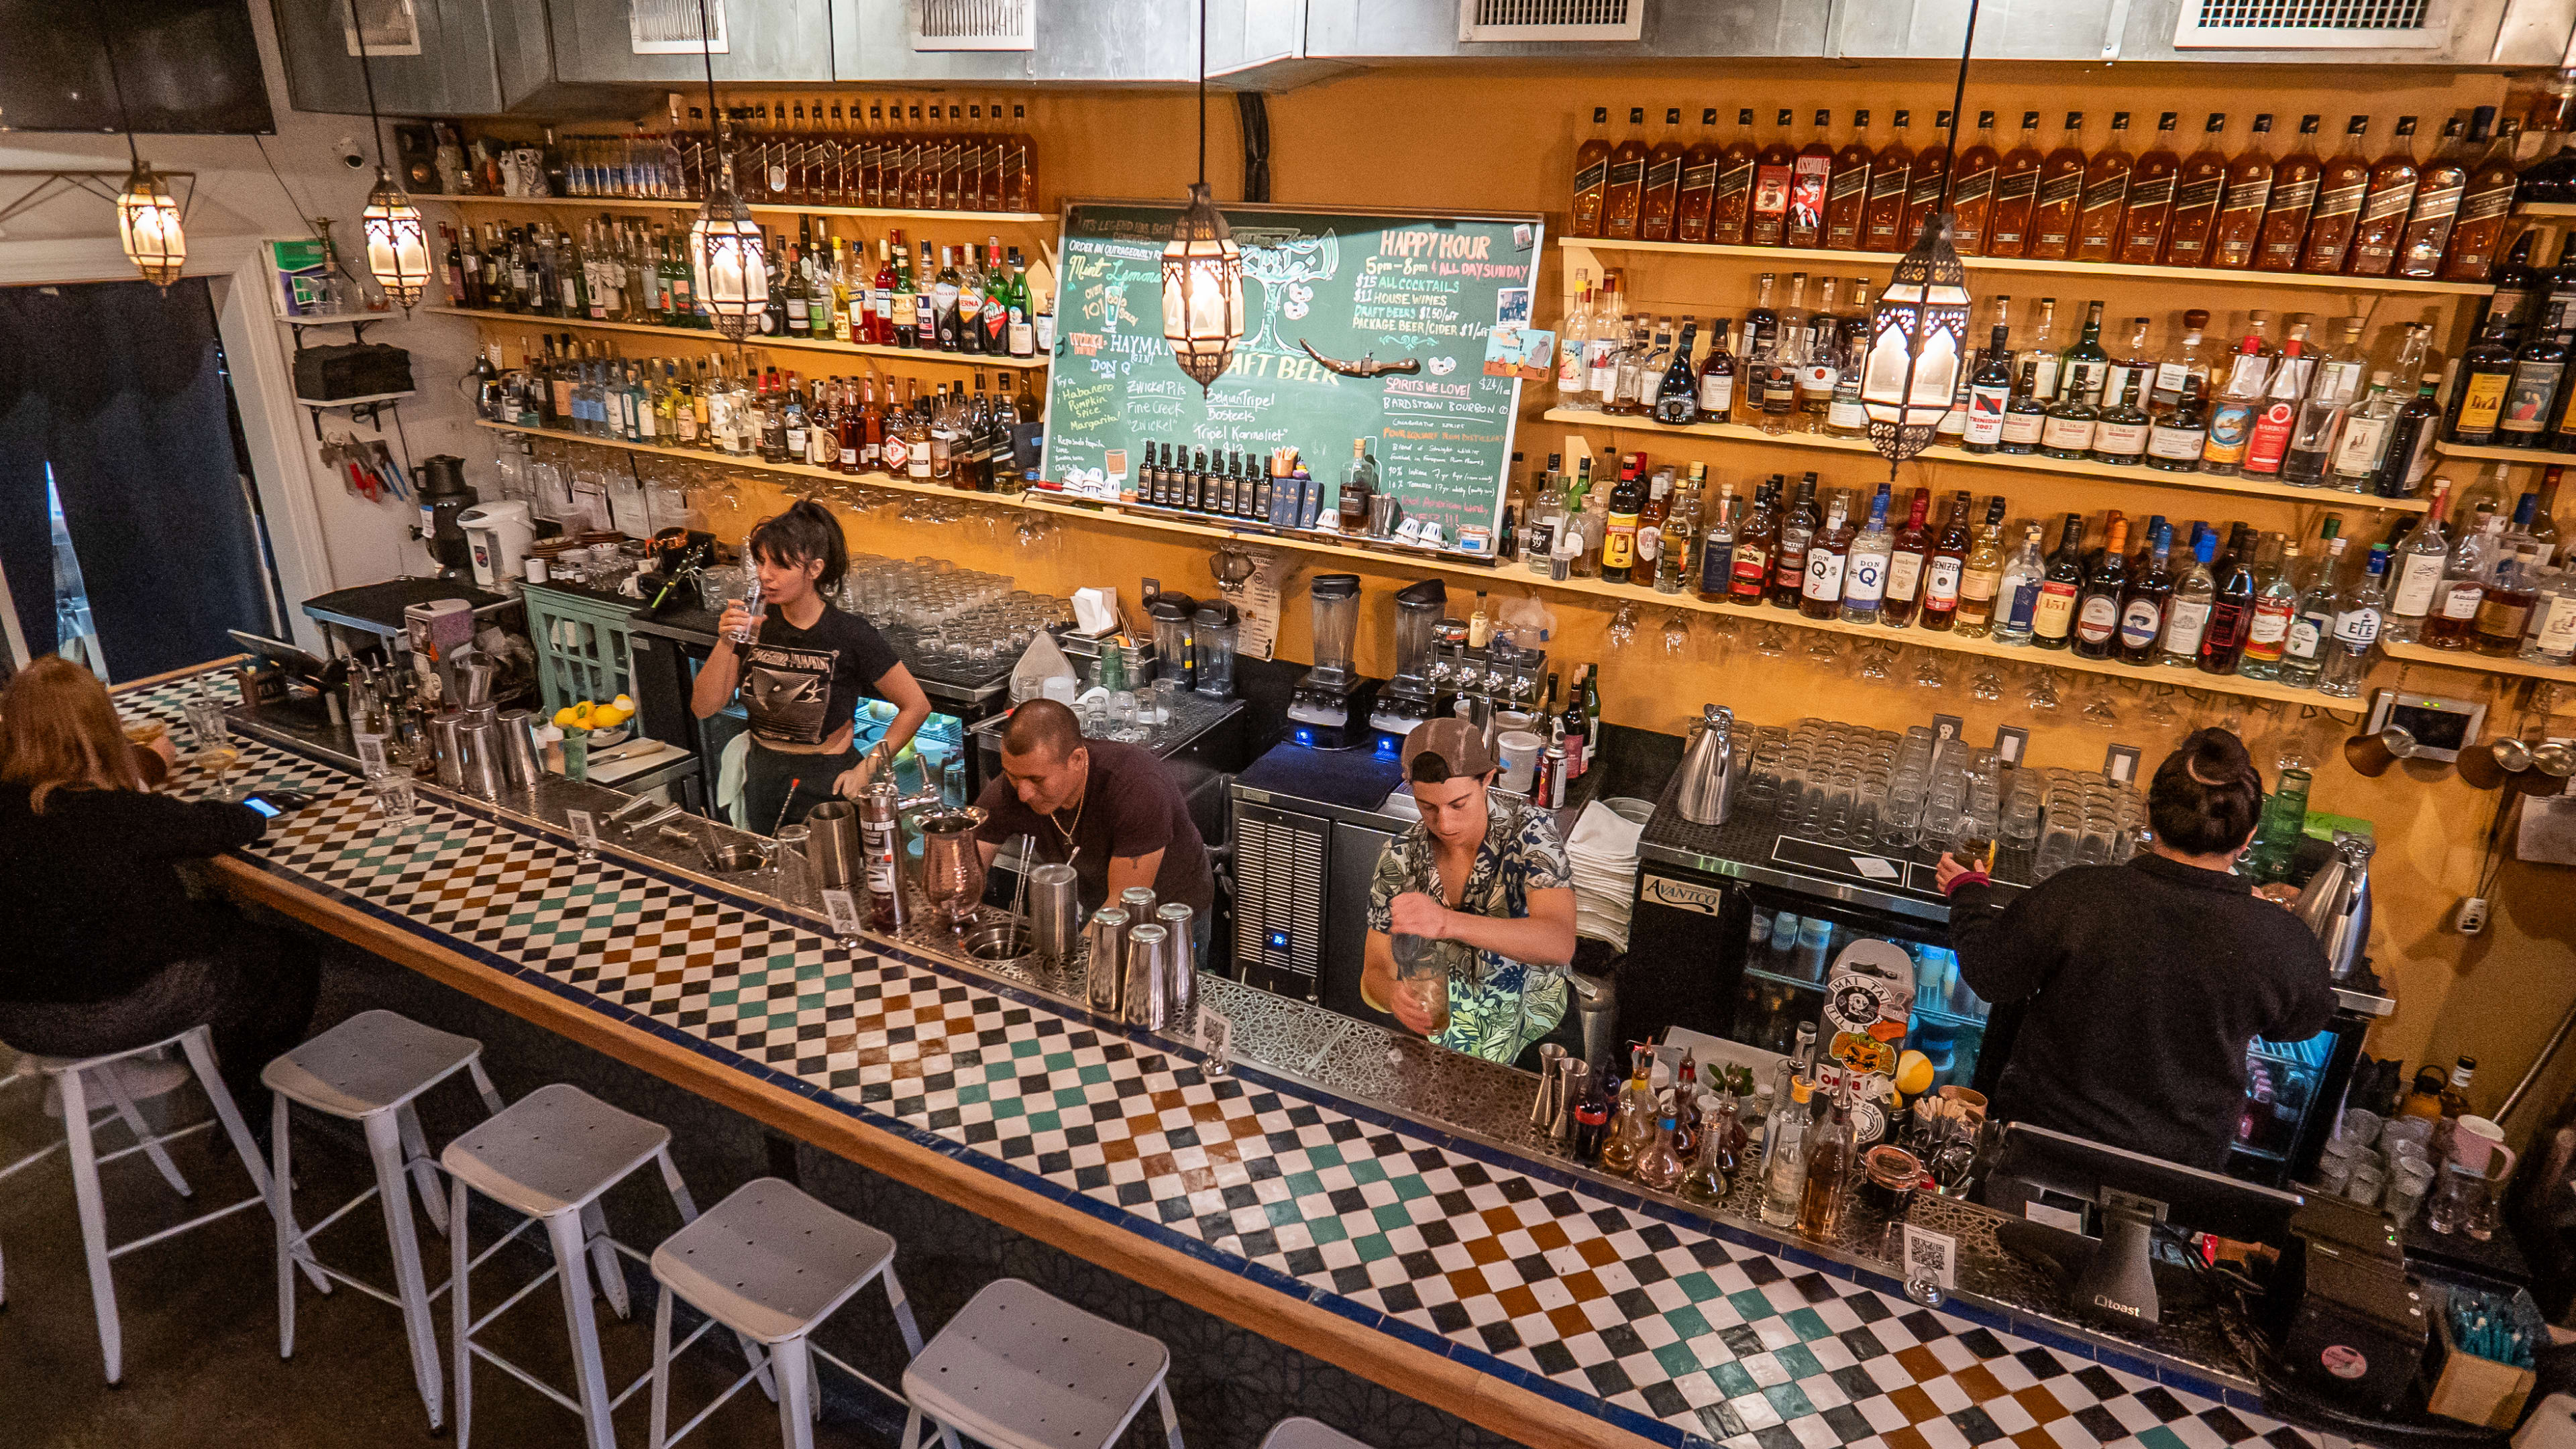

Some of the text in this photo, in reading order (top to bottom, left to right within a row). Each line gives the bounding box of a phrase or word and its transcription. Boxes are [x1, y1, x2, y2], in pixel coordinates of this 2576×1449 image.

[1069, 239, 1094, 254] ORDER
[1105, 244, 1154, 261] OUTRAGEOUSLY
[1380, 231, 1491, 261] HAPPY HOUR
[1068, 254, 1163, 283] Mint Lemona
[1438, 262, 1460, 276] ALL
[1460, 264, 1483, 282] DAY
[1482, 265, 1529, 283] SUNDAY
[1085, 284, 1104, 299] OVER
[1355, 272, 1460, 294] $15 ALL COCKTAILS
[1353, 288, 1448, 307] $11 HOUSE WINES
[1354, 304, 1385, 318] DRAFT
[1386, 306, 1416, 319] BEERS
[1352, 317, 1397, 331] PACKAGE
[1397, 319, 1458, 337] BEER/CIDER
[1121, 361, 1132, 376] Q
[1226, 352, 1277, 378] AFT
[1055, 375, 1066, 388] Try
[1385, 376, 1472, 397] SPIRITS WE LOVE!
[1068, 396, 1108, 412] Pumpkin
[1127, 402, 1151, 415] Fine
[1383, 397, 1443, 411] BARDSTOWN
[1448, 401, 1495, 415] BOURBON
[1206, 408, 1256, 423] Bosteels
[1969, 416, 2001, 424] TRINIDAD
[1223, 441, 1246, 458] $13
[1784, 545, 1799, 553] PARK
[1813, 554, 1830, 562] DON
[1812, 561, 1827, 580] Q
[1860, 560, 1880, 568] DON
[1931, 559, 1960, 572] DENIZEN
[1858, 567, 1878, 588] Q
[1812, 583, 1821, 595] 7
[1645, 879, 1717, 907] AVANTCO
[1834, 977, 1890, 1002] MAI TAI
[2108, 1299, 2141, 1317] toast
